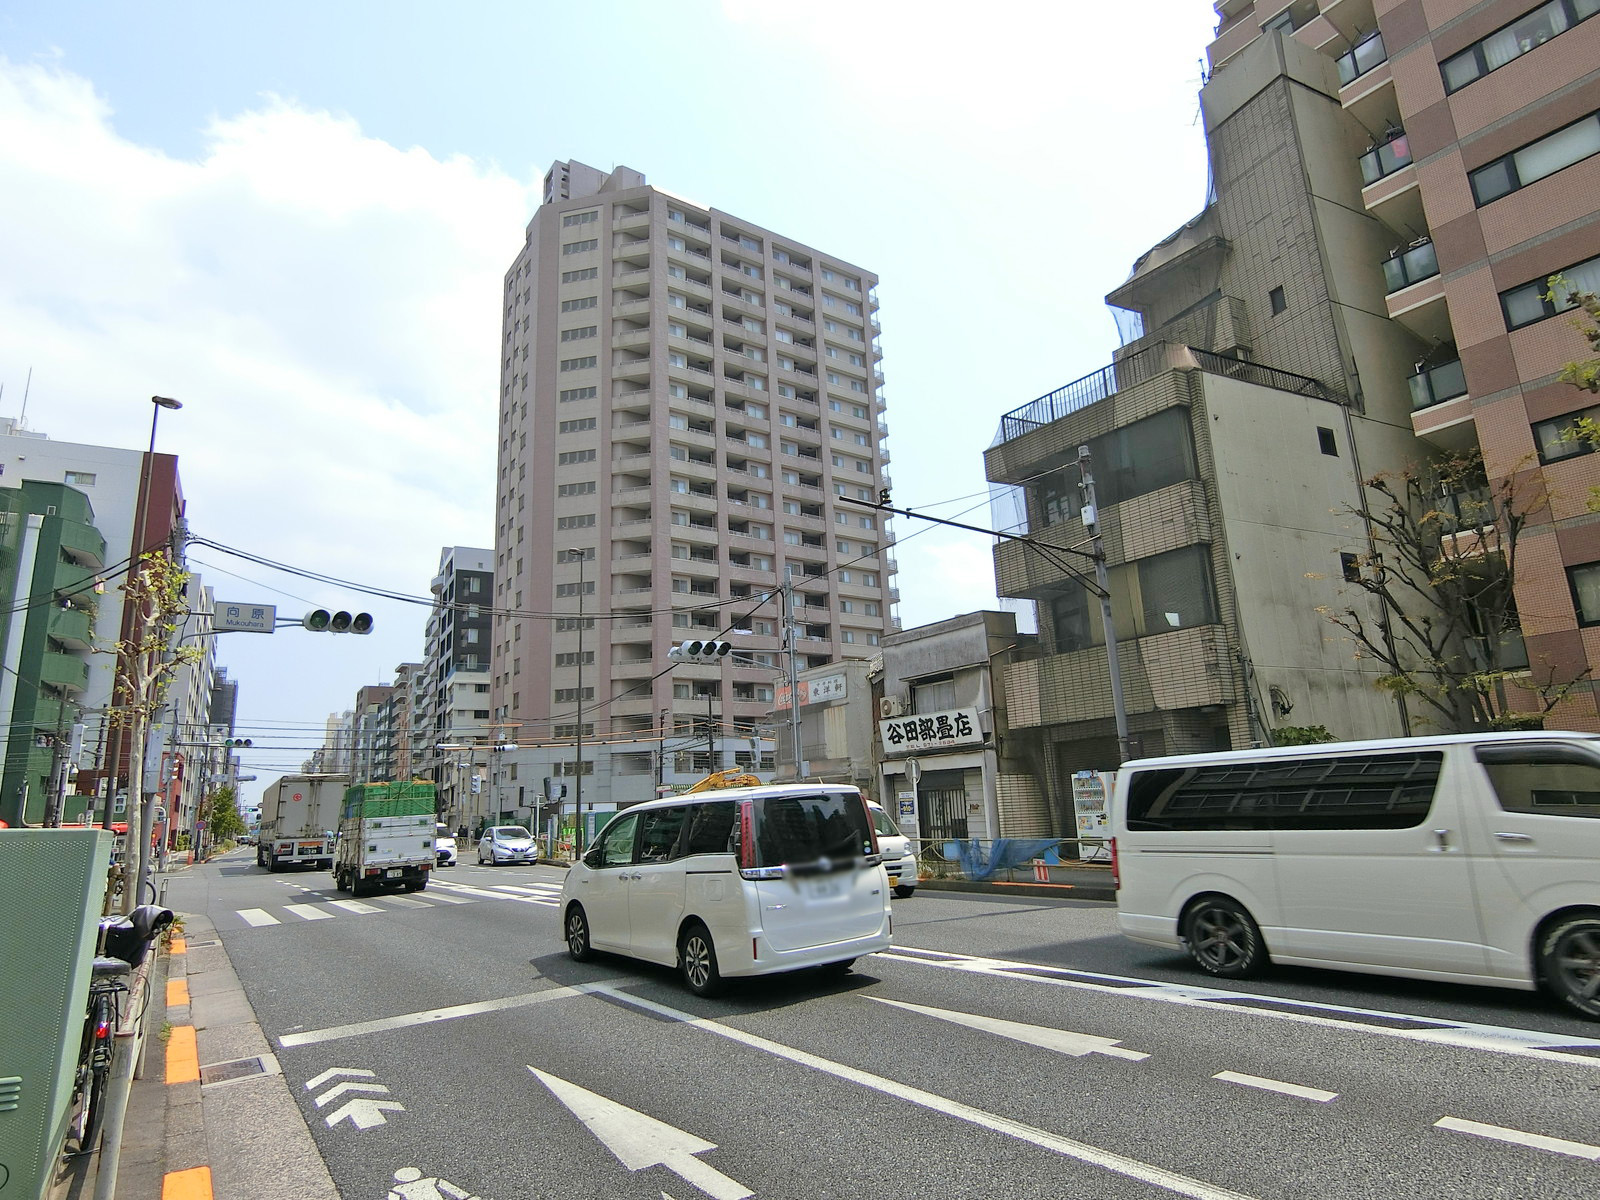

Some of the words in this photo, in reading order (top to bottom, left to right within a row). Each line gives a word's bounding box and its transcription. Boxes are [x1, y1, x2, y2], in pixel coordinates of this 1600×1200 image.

[227, 606, 265, 620] 向原
[226, 619, 264, 628] Mukouhara
[887, 712, 973, 745] 谷田部畳店
